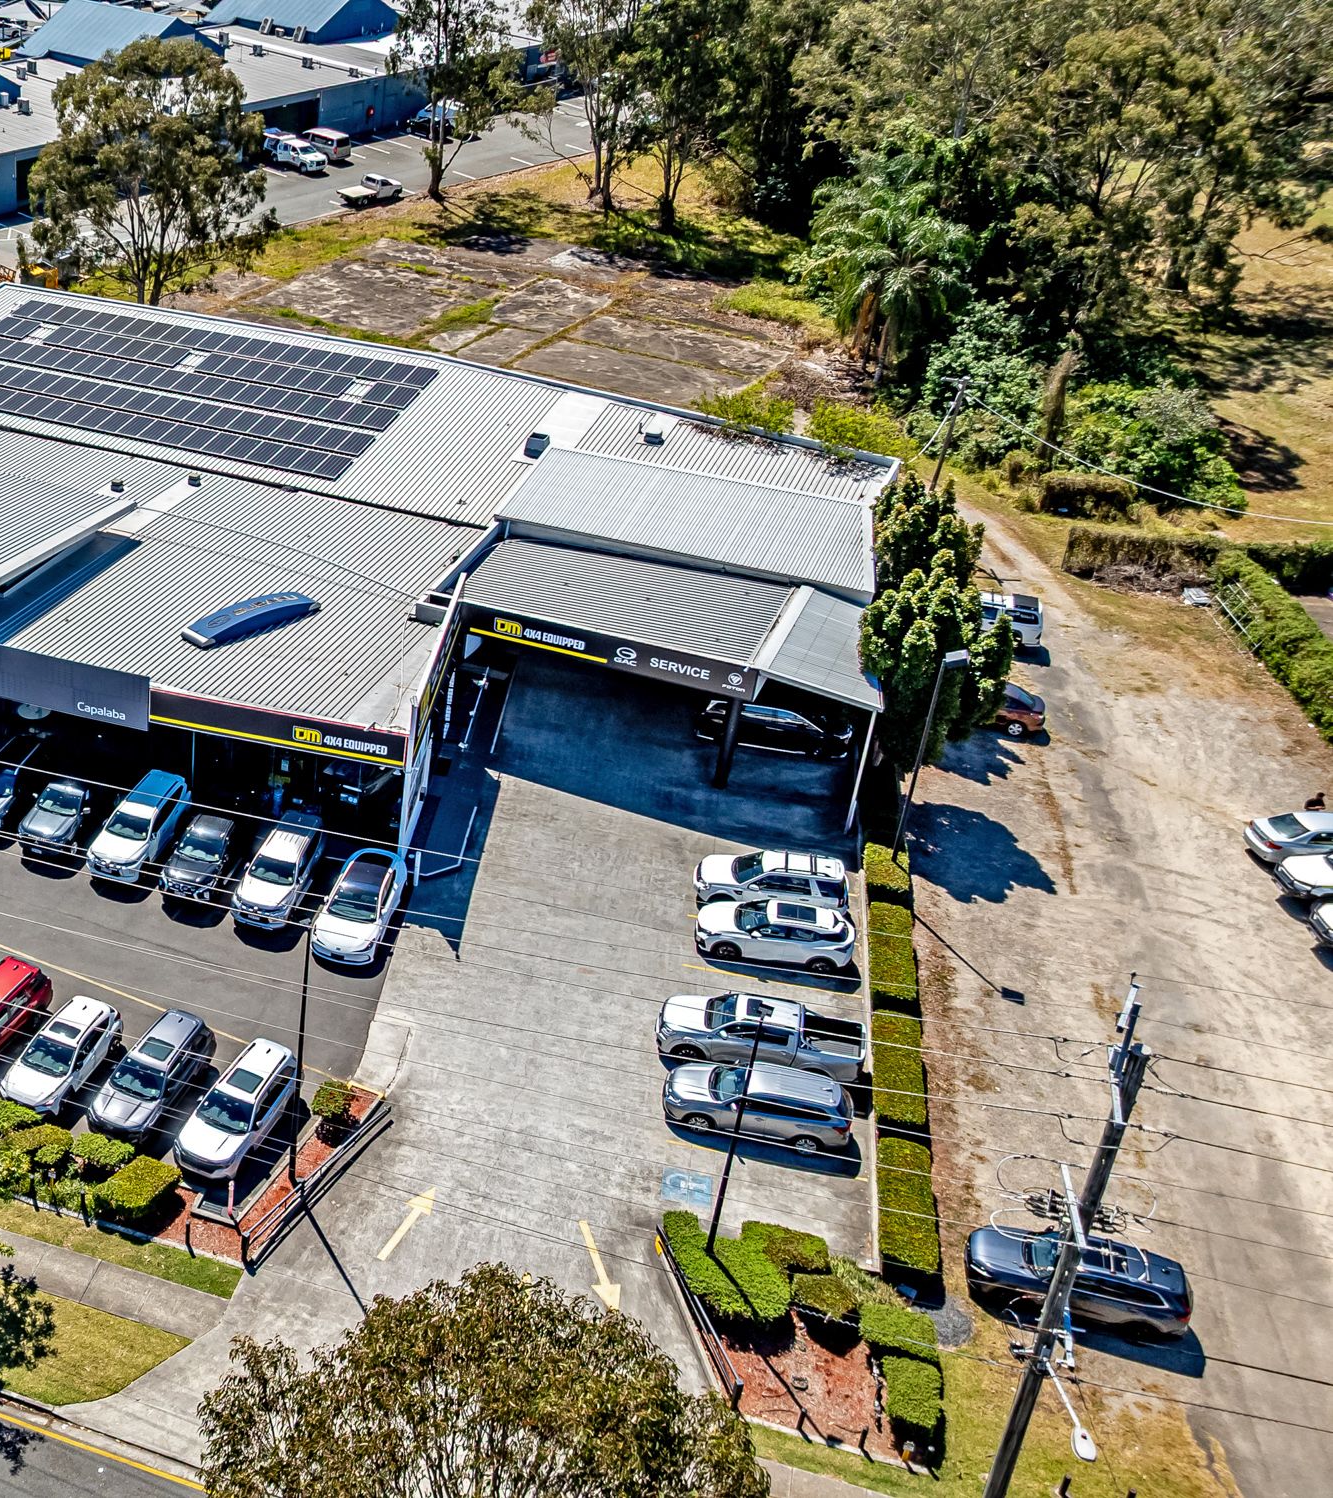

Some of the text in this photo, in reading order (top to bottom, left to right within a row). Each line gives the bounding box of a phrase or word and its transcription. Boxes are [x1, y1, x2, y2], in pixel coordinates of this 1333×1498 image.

[542, 632, 586, 651] EQUIPPED
[613, 656, 637, 667] GAC
[650, 657, 711, 680] SERVICE
[77, 701, 126, 720] Capalaba
[343, 738, 388, 756] EQUIPPED
